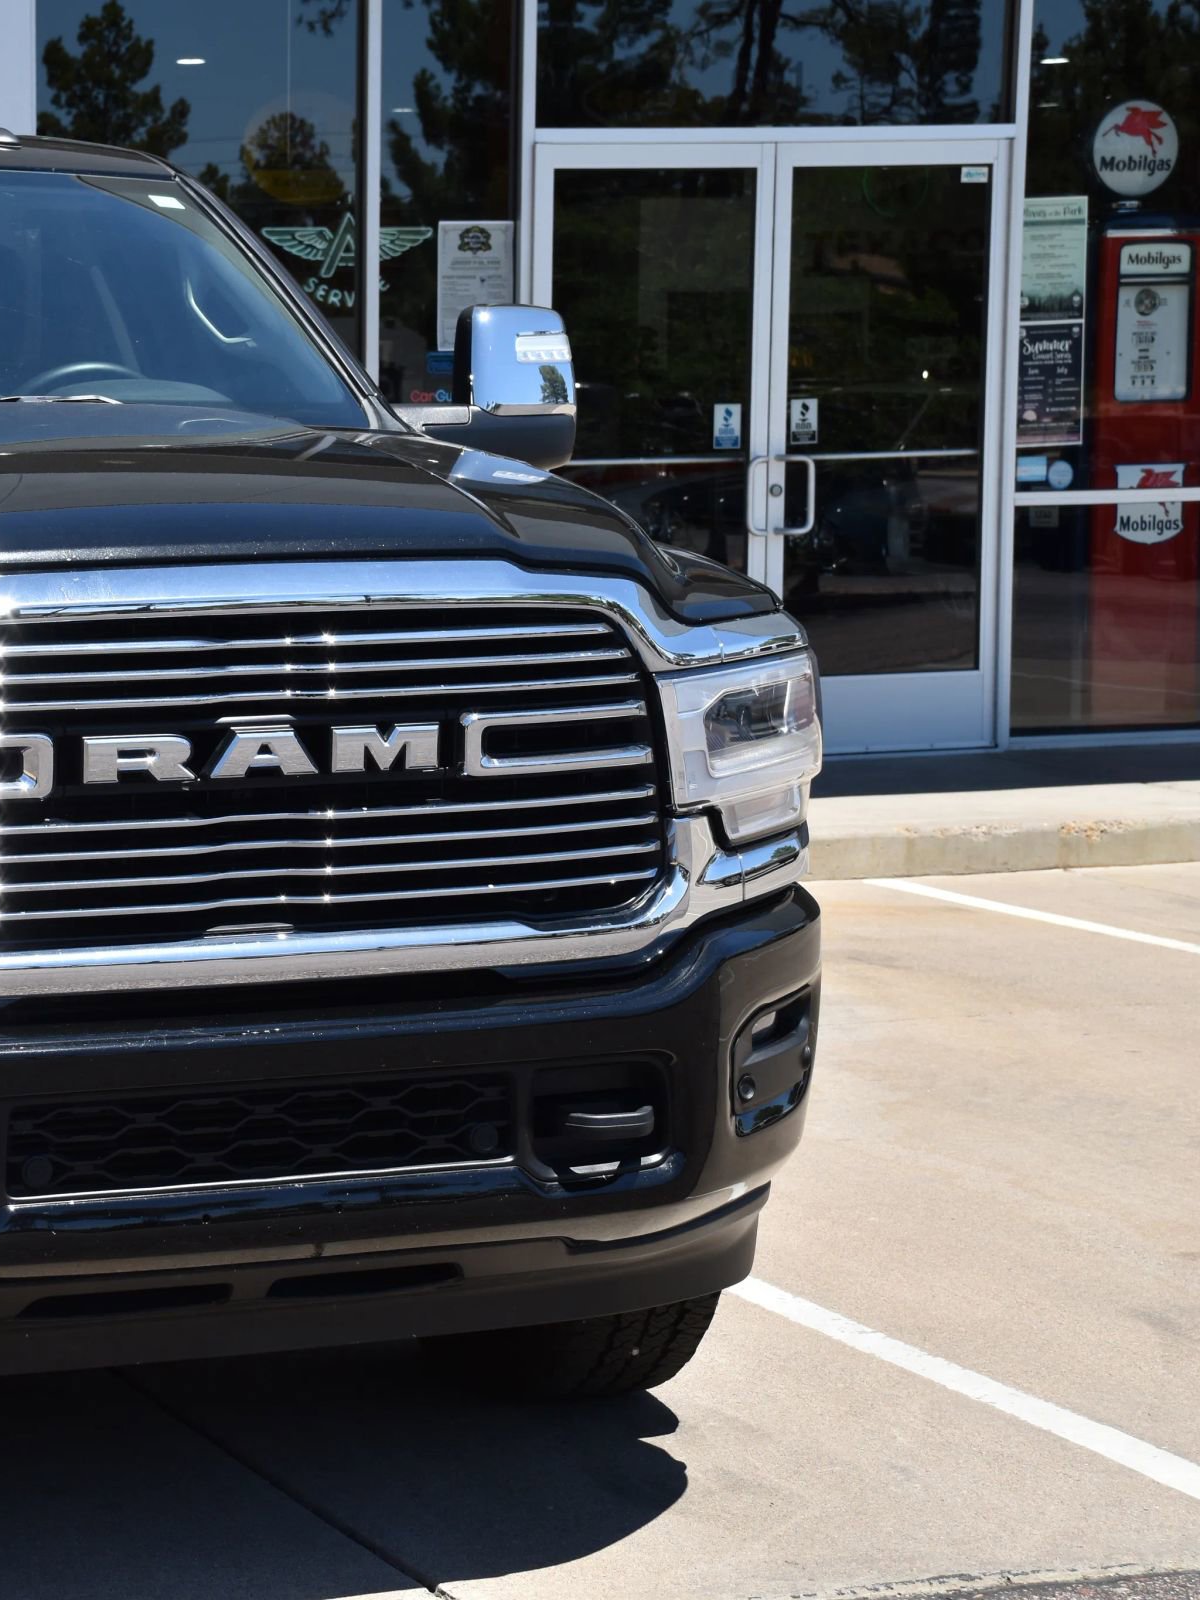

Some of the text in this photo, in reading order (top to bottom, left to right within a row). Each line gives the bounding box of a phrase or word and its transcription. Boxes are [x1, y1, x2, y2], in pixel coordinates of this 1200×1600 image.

[1100, 154, 1171, 177] Mobilgas
[1127, 251, 1181, 270] Mobilgas
[1023, 338, 1072, 356] Summer
[1120, 514, 1180, 536] Mobilgas
[83, 714, 440, 785] RAM
